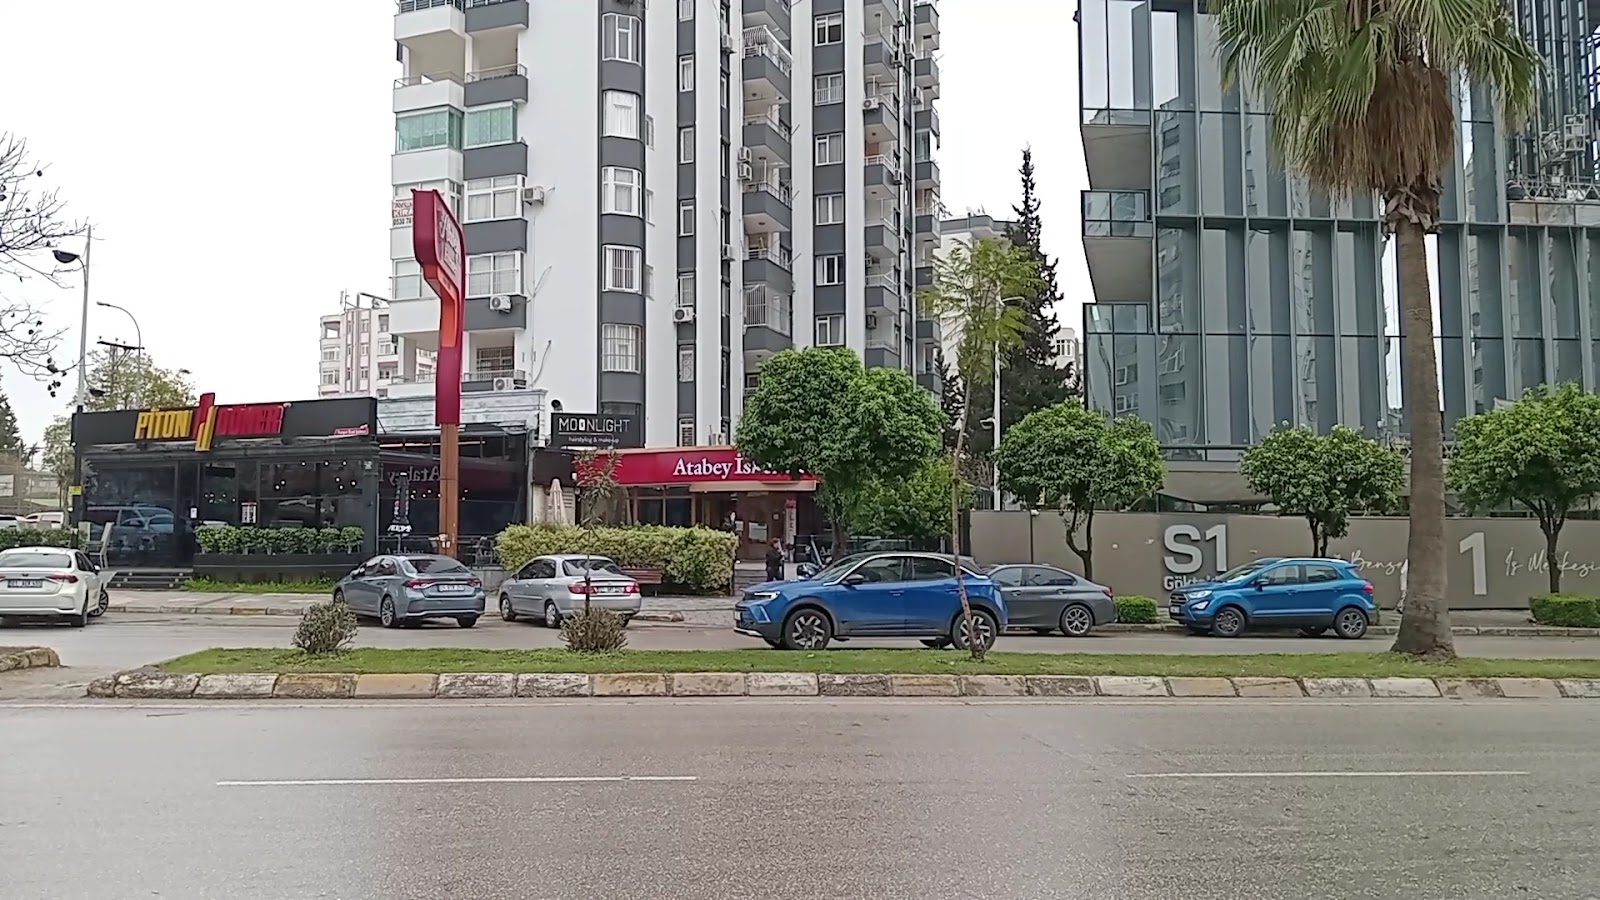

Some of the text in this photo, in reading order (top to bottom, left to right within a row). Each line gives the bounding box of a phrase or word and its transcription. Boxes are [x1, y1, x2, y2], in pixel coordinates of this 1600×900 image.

[135, 407, 193, 439] PİTON
[558, 417, 631, 433] MOONLIGHT
[672, 457, 733, 480] Atabey
[1164, 524, 1227, 573] S1
[1459, 532, 1487, 595] 1
[1528, 549, 1600, 578] Mekezi
